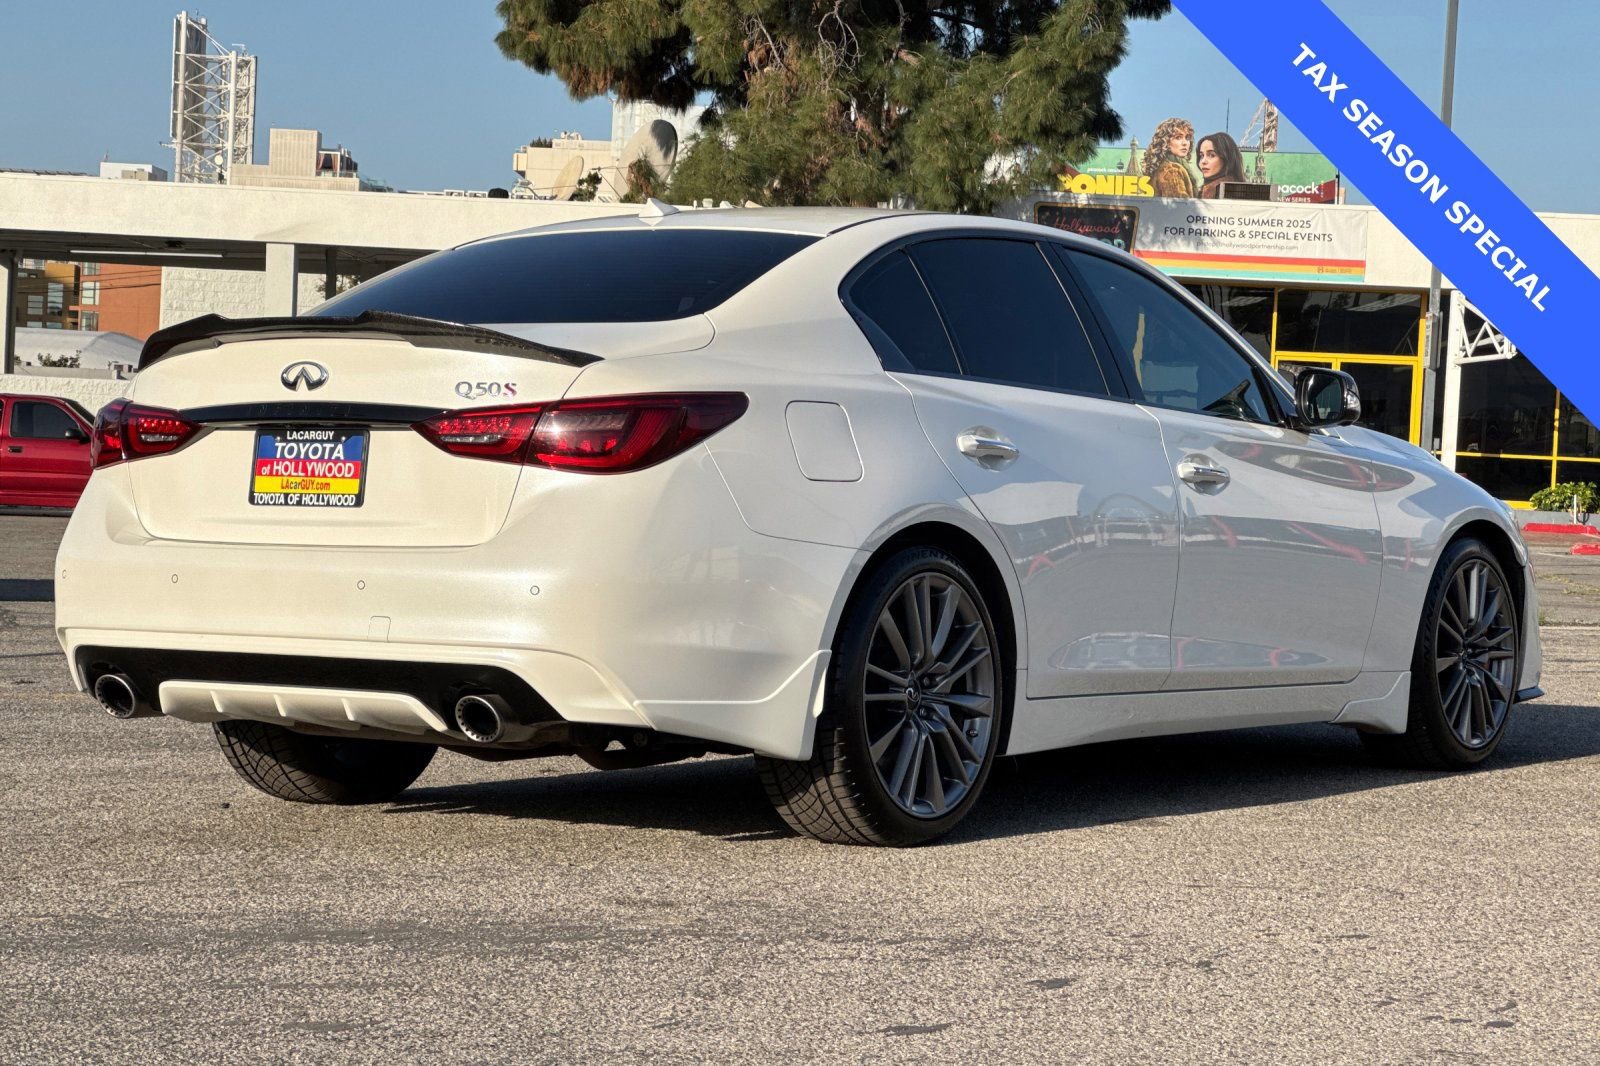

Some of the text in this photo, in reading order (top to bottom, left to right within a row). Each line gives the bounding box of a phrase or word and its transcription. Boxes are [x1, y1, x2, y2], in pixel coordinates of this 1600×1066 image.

[1052, 216, 1121, 235] Hollywood
[1186, 214, 1312, 229] OPENING SUMMER 2025
[1164, 226, 1333, 242] FOR PARKING & SPECIAL EVENTS
[286, 430, 335, 441] LACARGUY
[274, 442, 345, 460] TOYOTA
[261, 460, 355, 478] of HOLLYWOOD
[280, 479, 331, 491] LAcarGUY.com
[253, 492, 356, 506] TOYOTA OF HOLLYWOOD
